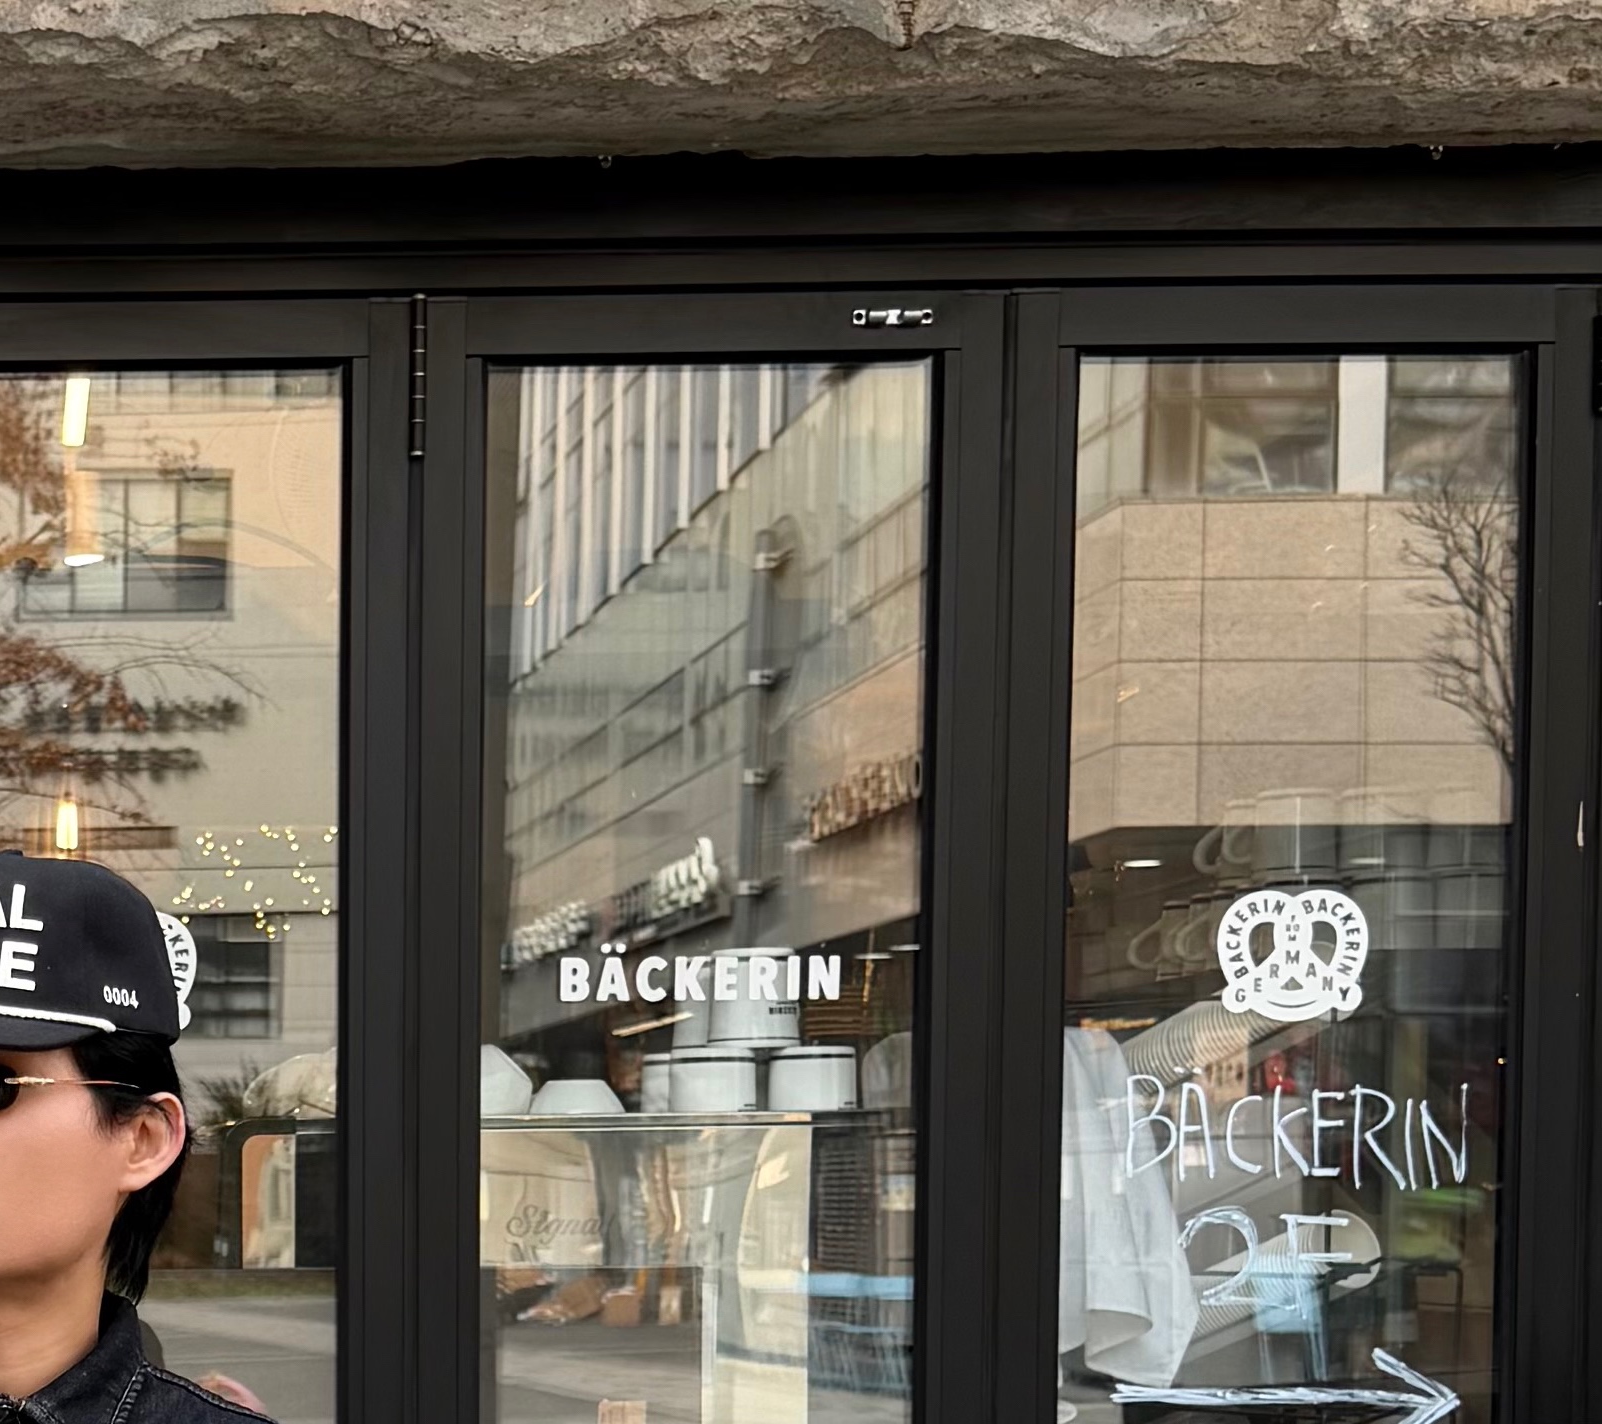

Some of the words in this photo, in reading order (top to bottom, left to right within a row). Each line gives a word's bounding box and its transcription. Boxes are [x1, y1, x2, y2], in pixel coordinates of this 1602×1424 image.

[162, 923, 190, 991] KERI
[559, 943, 841, 1002] BÄCKERIN
[1234, 950, 1351, 1004] GERMANY
[103, 985, 139, 1009] 0004
[1126, 1066, 1468, 1190] BÄCKERIN
[1176, 1205, 1352, 1319] 2F
